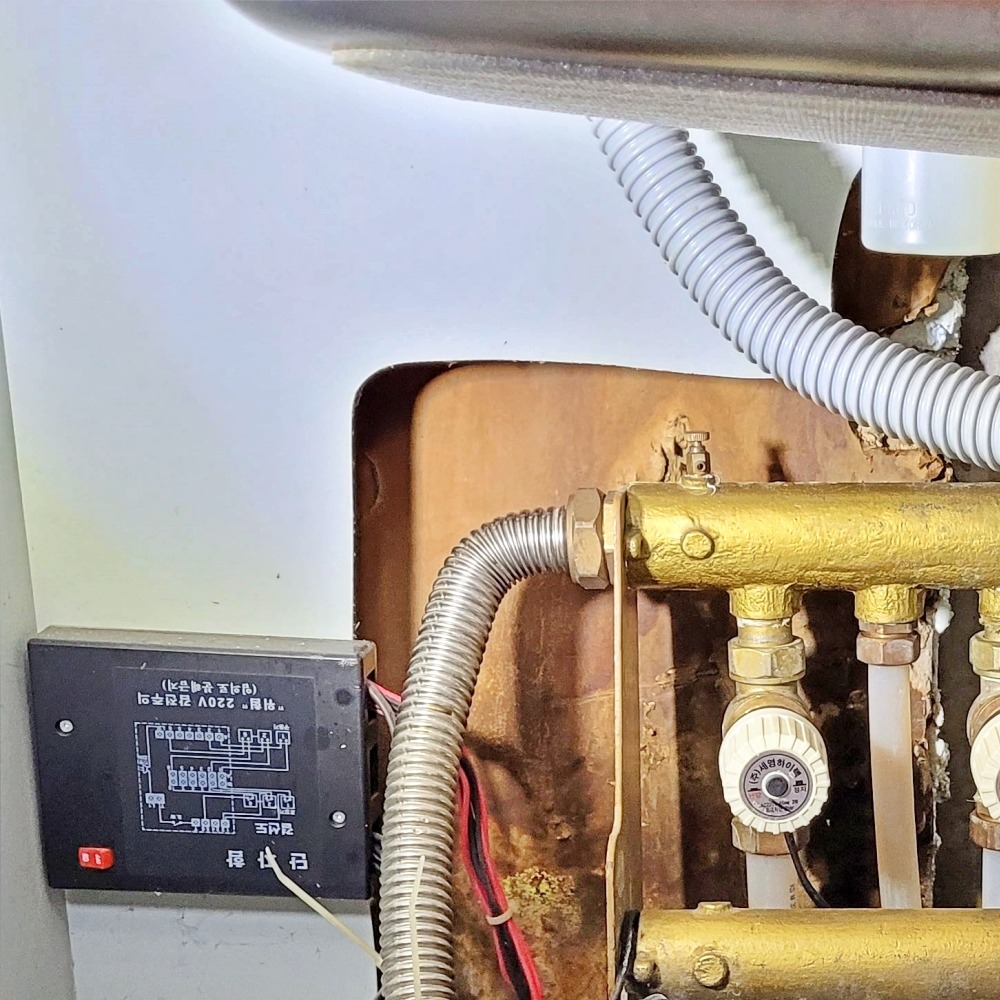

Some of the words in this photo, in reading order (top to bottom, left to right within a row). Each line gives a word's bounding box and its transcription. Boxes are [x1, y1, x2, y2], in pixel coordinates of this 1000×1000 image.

[136, 691, 192, 707] 감전주의
[198, 695, 235, 709] 220V
[253, 820, 295, 836] 결선도
